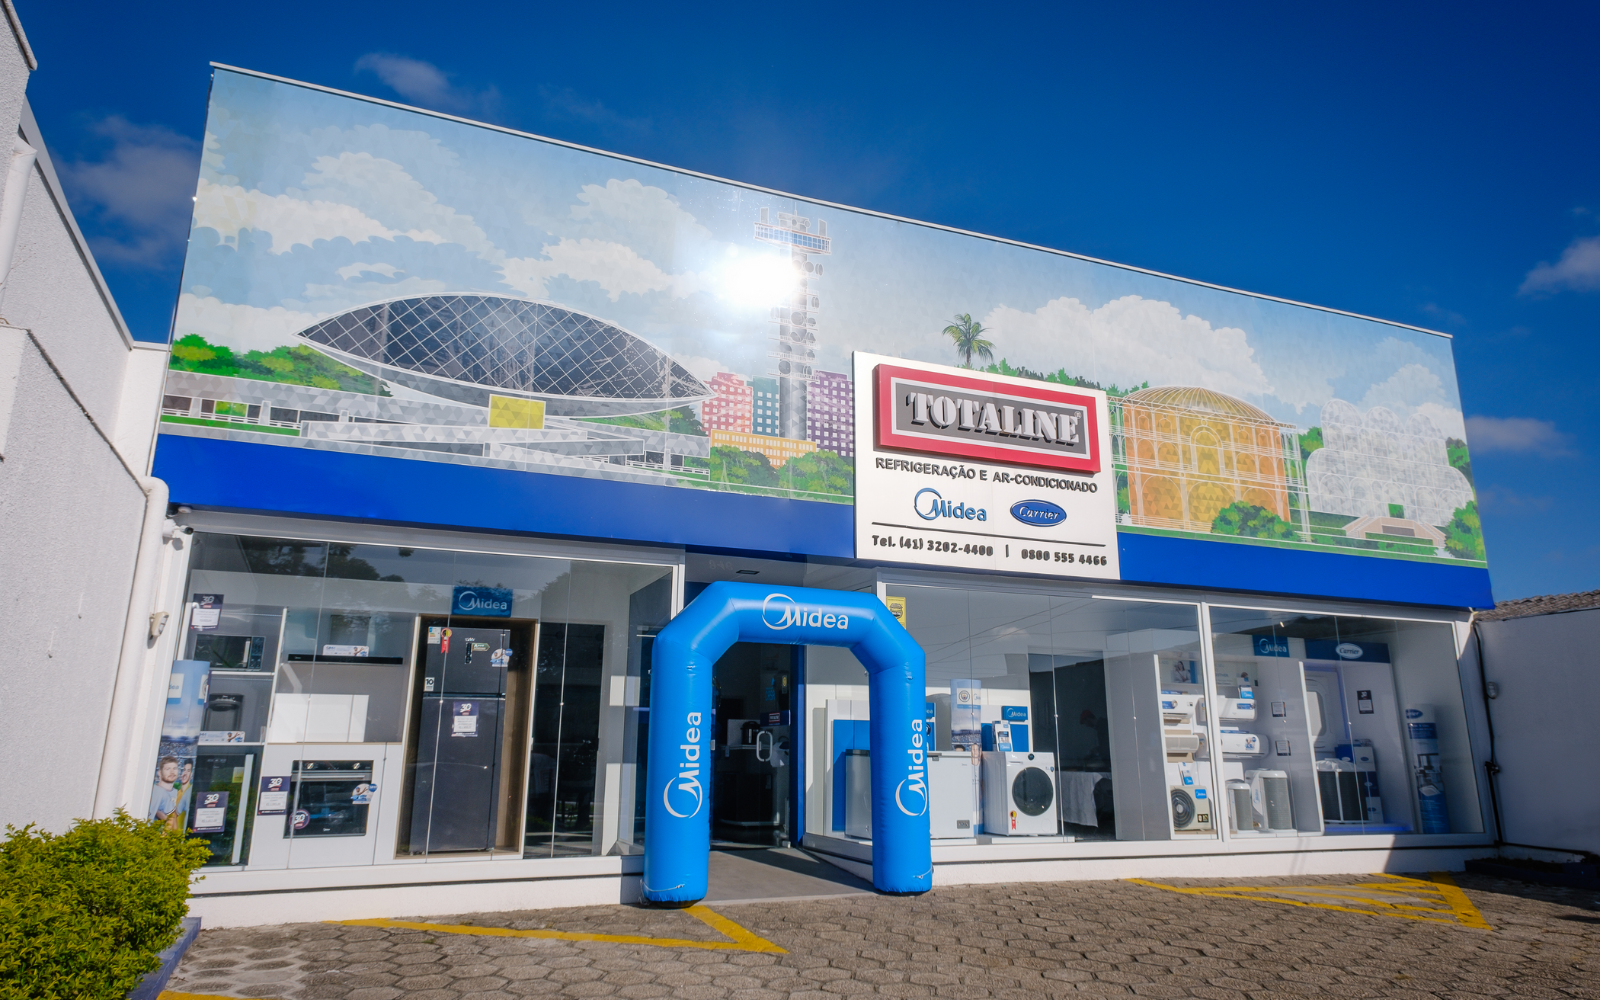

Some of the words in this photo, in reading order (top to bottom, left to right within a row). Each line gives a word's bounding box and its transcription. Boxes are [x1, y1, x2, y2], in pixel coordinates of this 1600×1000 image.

[907, 392, 1079, 446] TOTALINE
[876, 457, 976, 480] REFRIGERAÇÃO
[980, 469, 988, 481] E
[993, 471, 1098, 493] AR-CONDICIONADO
[914, 487, 987, 521] Midea
[1019, 506, 1060, 519] Carrier
[872, 535, 896, 548] Tel.
[899, 536, 924, 550] (41)
[927, 540, 994, 556] 3202-4400
[1021, 549, 1050, 561] 0800
[1054, 551, 1075, 563] 555
[1079, 554, 1107, 566] 4466
[459, 591, 508, 611] Midea
[762, 593, 849, 630] Midea
[1260, 638, 1287, 654] Midea
[1339, 647, 1360, 655] Carrier
[1006, 708, 1027, 718] Midea
[664, 712, 703, 819] Midea
[895, 719, 928, 817] Midea
